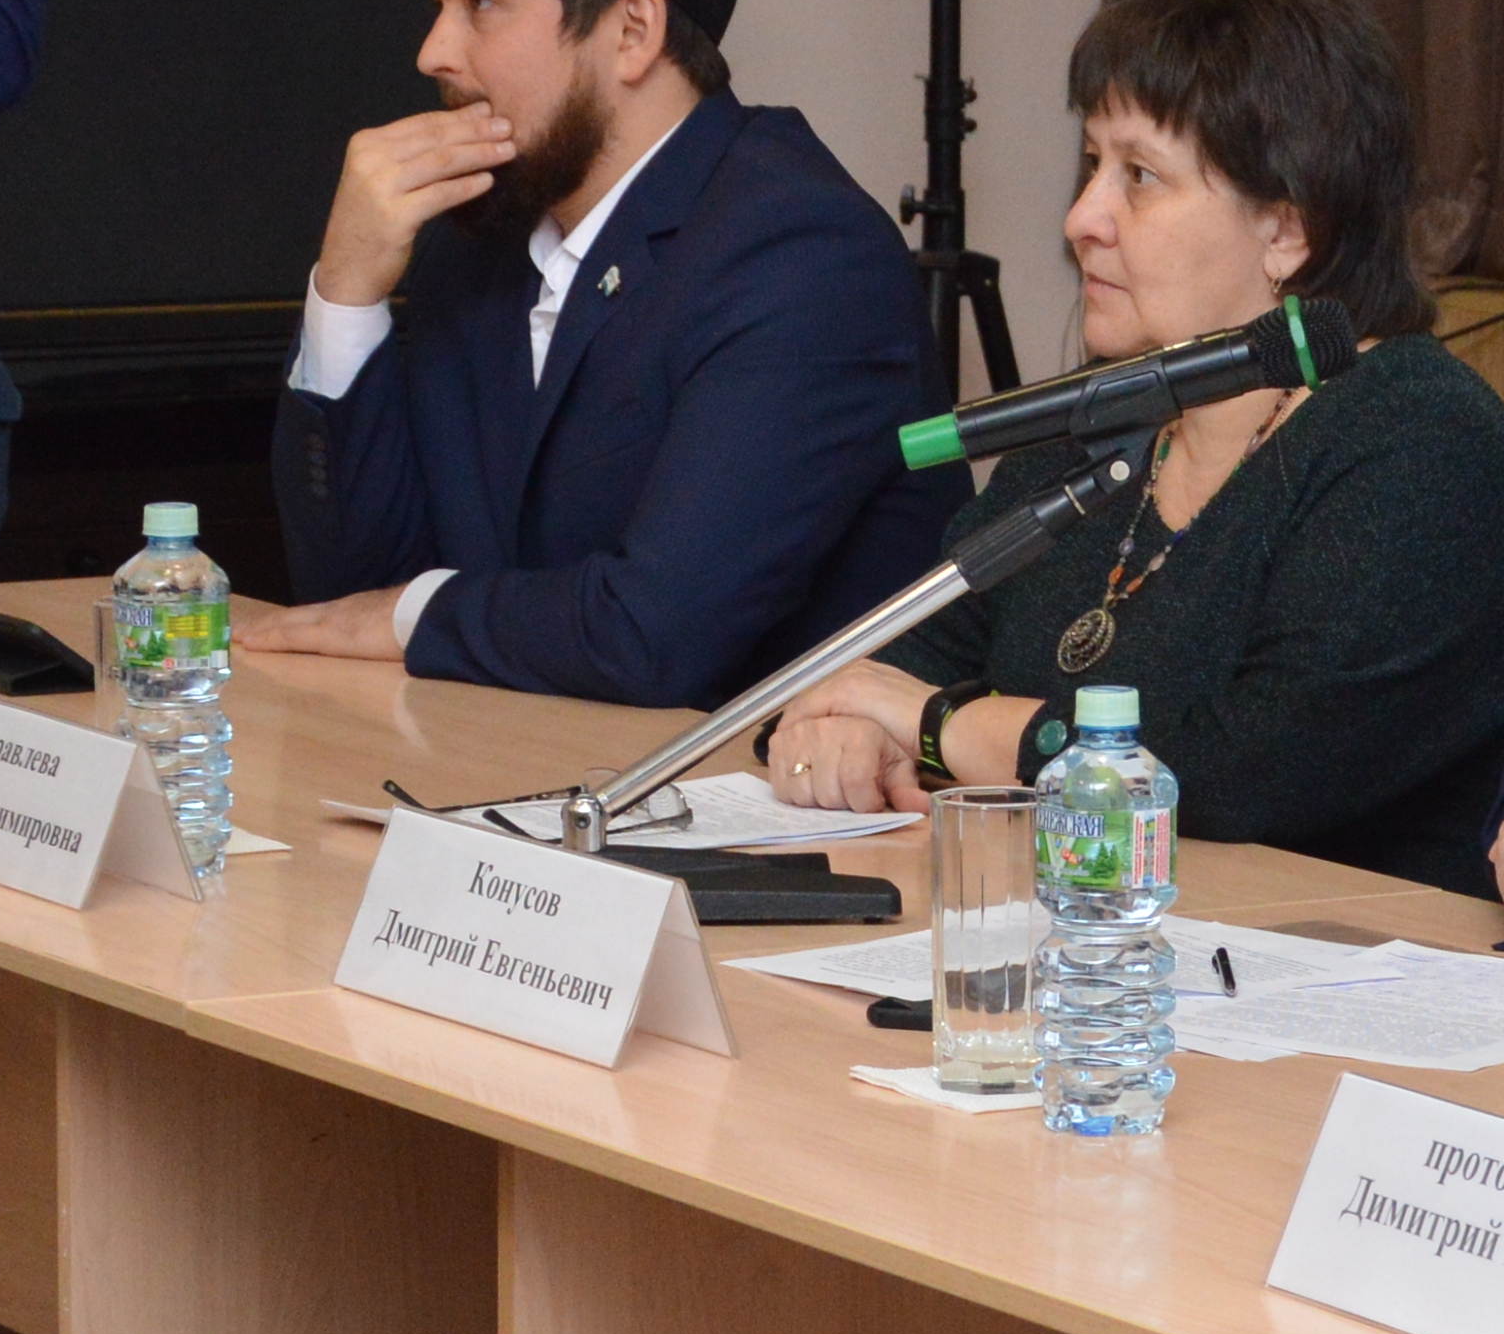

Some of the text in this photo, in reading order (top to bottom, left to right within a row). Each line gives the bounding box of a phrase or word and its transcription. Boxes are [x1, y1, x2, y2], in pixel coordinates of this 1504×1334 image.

[468, 861, 562, 917] Конусов
[373, 909, 614, 1010] Дмитрий Евгеньевич
[1340, 1175, 1504, 1261] Димитрий
